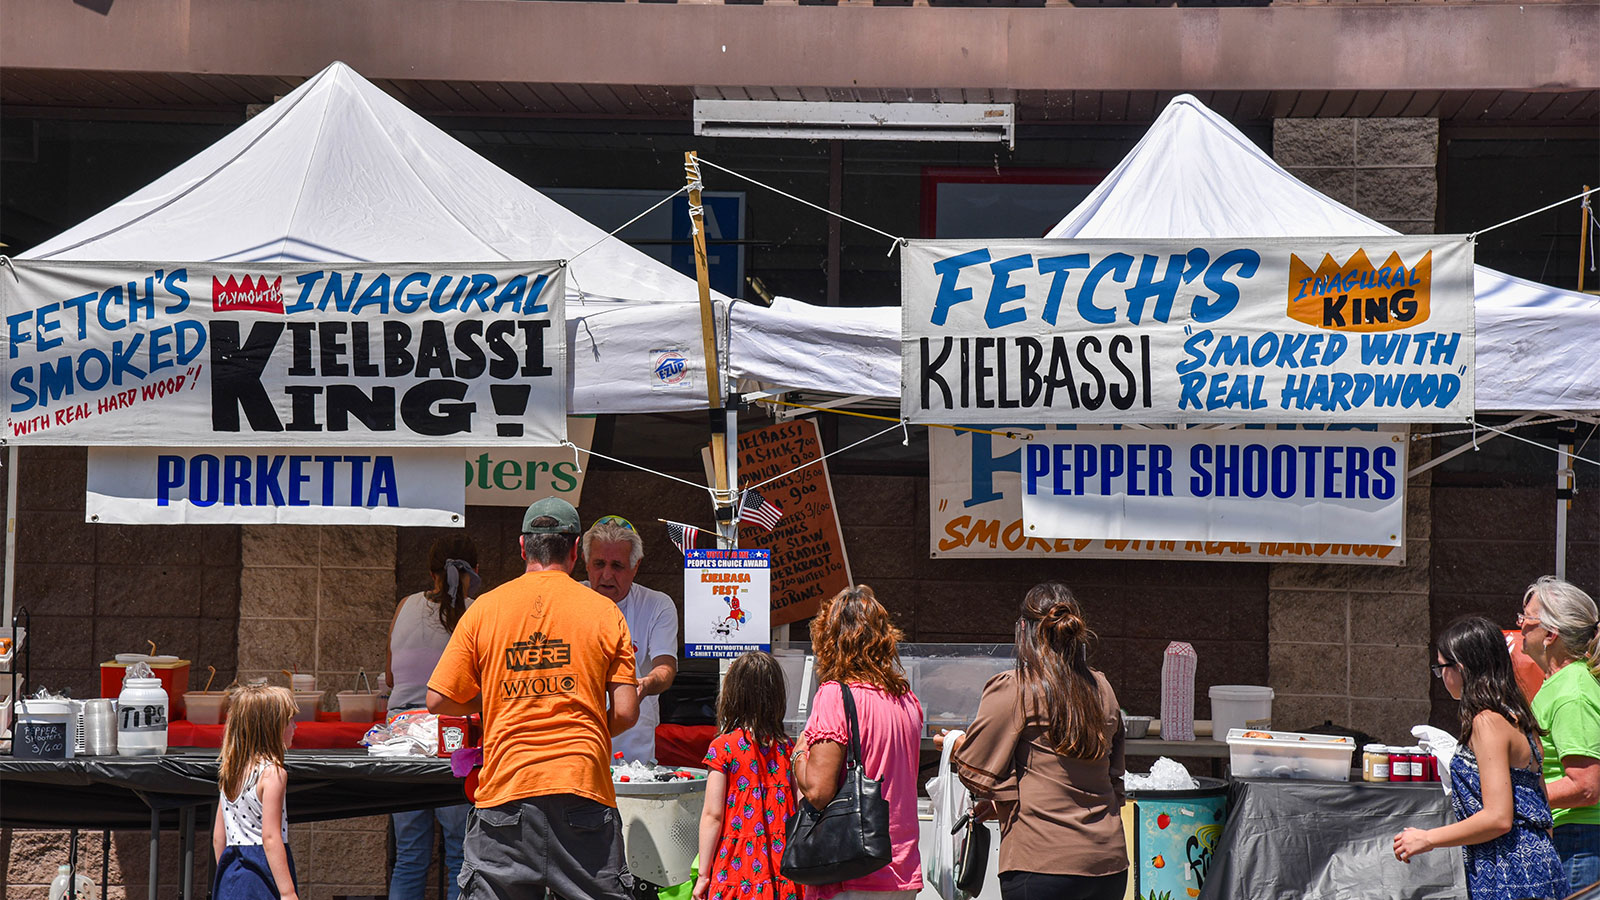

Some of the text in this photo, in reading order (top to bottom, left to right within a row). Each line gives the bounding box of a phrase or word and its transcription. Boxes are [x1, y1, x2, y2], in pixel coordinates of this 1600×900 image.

[285, 270, 549, 316] INAGURAL
[930, 247, 1261, 330] FETCH'S
[1293, 265, 1421, 303] INAGURAL
[6, 267, 191, 360] FETCH'S
[1322, 288, 1419, 328] KING
[10, 319, 208, 413] SMOKED
[1361, 331, 1462, 366] WITH
[919, 334, 1153, 411] KIELBASSI
[55, 402, 92, 427] REAL
[97, 388, 138, 415] HARD
[1177, 371, 1268, 412] REAL
[737, 425, 803, 455] IELBASSI
[157, 454, 401, 508] PORKETTA
[1026, 443, 1174, 497] PEPPER
[1190, 443, 1397, 501] SHOOTERS
[752, 521, 809, 548] TOPPINGS
[786, 527, 824, 550] SLAW
[687, 559, 768, 568] PEOPLE'S CHOICE AWARD
[706, 550, 723, 559] VOTE
[738, 550, 749, 559] ME
[701, 573, 751, 583] KIELBASA
[712, 585, 740, 596] FEST
[507, 646, 569, 667] WBRE
[503, 676, 558, 697] WYOU
[121, 704, 166, 729] TIPS
